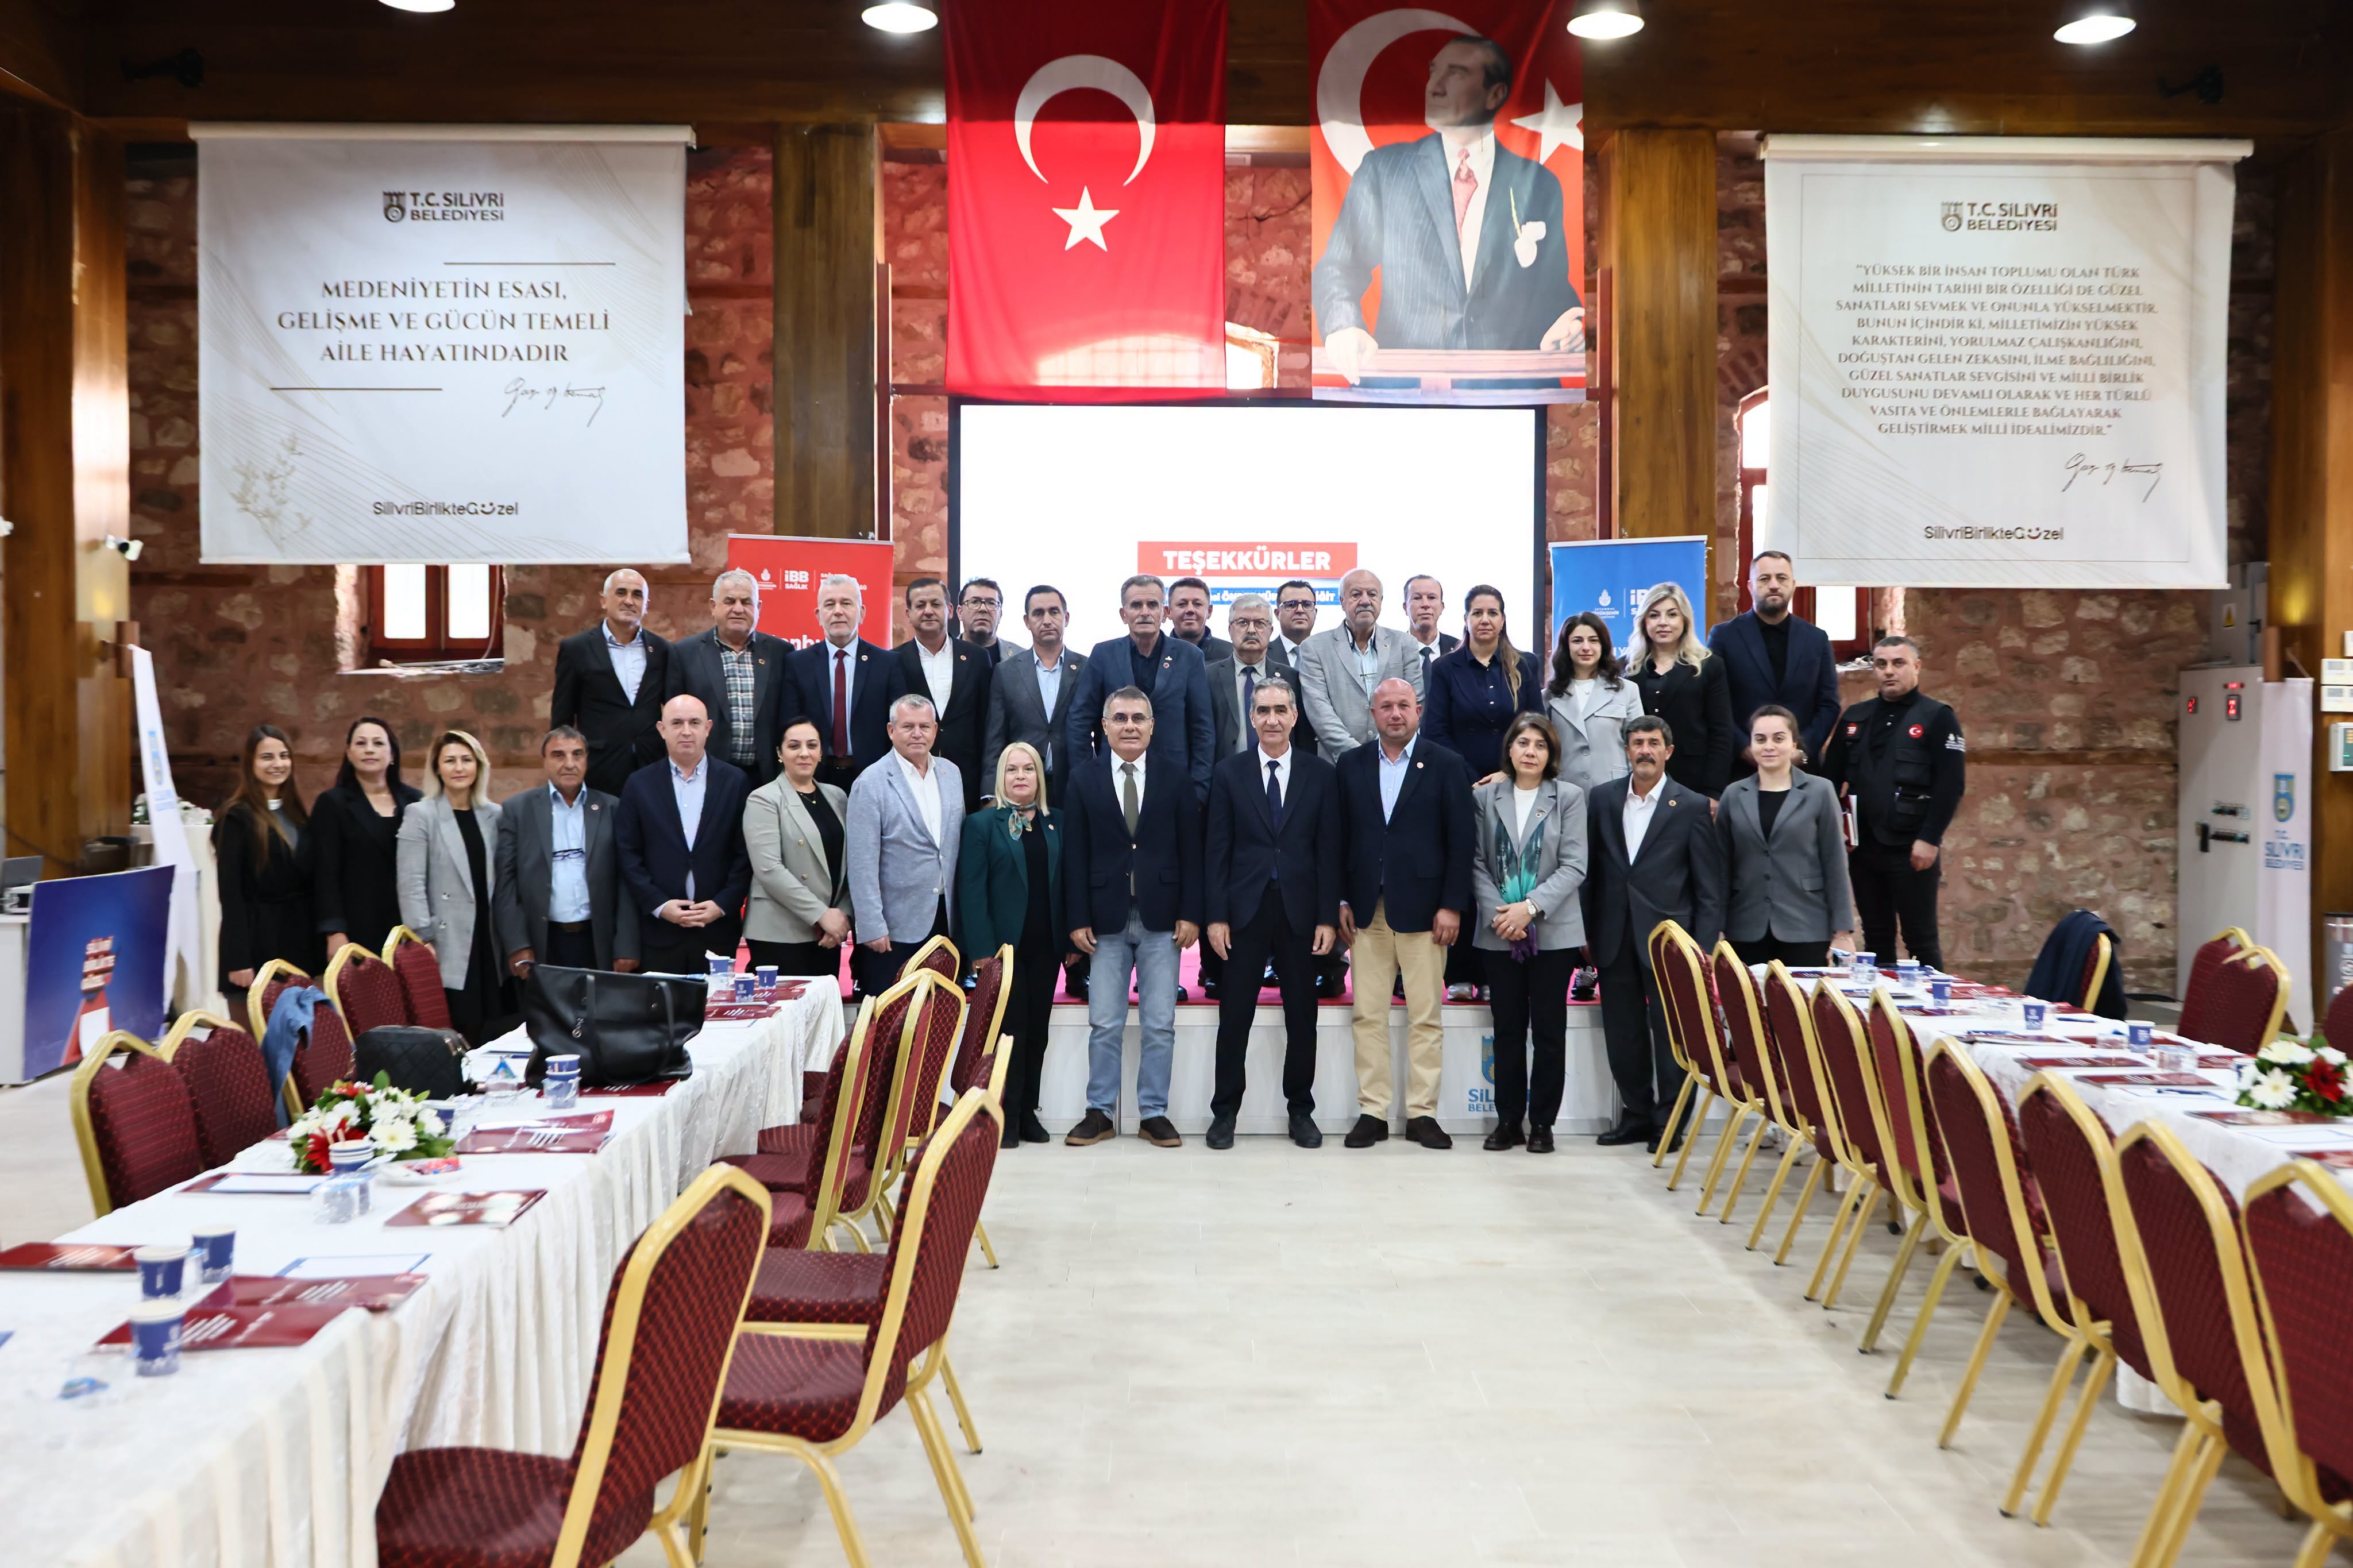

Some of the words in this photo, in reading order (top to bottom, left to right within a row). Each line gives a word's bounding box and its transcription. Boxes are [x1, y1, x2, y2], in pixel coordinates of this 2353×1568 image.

[410, 192, 439, 207] T.C.
[1967, 203, 1996, 217] T.C.
[1919, 264, 1941, 276] BİR
[1945, 264, 1986, 276] İNSAN
[1990, 266, 2058, 277] TOPLUMU
[2061, 267, 2099, 278] OLAN
[2103, 265, 2140, 278] TÜRK
[321, 277, 489, 298] MEDENİYETİN
[499, 281, 566, 300] ESASI,
[1853, 281, 1932, 294] MİLLETİNİN
[1935, 281, 1982, 294] TARİHİ
[1986, 283, 2008, 295] BİR
[2011, 282, 2073, 295] ÖZELLİĞİ
[2076, 285, 2096, 295] DE
[2098, 283, 2143, 296] GÜZEL
[1836, 300, 1911, 311] SANATLARI
[1914, 301, 1967, 311] SEVMEK
[1971, 301, 1988, 312] VE
[1991, 302, 2050, 312] ONUNLA
[277, 308, 382, 333] GELİŞME
[389, 312, 418, 329] VE
[425, 309, 516, 330] GÜCÜN
[523, 309, 610, 330] TEMELİ
[1857, 318, 1906, 328] BUNUN
[1910, 316, 1965, 331] İÇİNDİR
[1968, 316, 1985, 330] Kİ,
[1989, 318, 2081, 330] MİLLETİMİZİN
[2085, 318, 2138, 331] YÜKSEK
[1852, 335, 1947, 347] KARAKTERİNİ,
[1950, 336, 2025, 347] YORULMAZ
[320, 340, 373, 361] AİLE
[380, 344, 569, 361] HAYATINDADIR
[1838, 351, 1914, 366] DOĞUŞTAN
[1918, 353, 1962, 364] GELEN
[1966, 354, 2031, 366] ZEKASINI,
[2034, 353, 2067, 365] İLME
[1849, 368, 1893, 380] GÜZEL
[1896, 371, 1966, 381] SANATLAR
[1970, 370, 2036, 383] SEVGİSİNİ
[2039, 372, 2058, 383] VE
[2059, 371, 2096, 383] MİLLİ
[2099, 371, 2144, 384] BİRLİK
[1842, 388, 1928, 399] DUYGUSUNU
[1932, 389, 1992, 399] DEVAMLI
[1996, 390, 2051, 400] OLARAK
[2055, 390, 2072, 400] VE
[2074, 391, 2101, 401] HER
[2105, 388, 2152, 401] TÜRLÜ
[1870, 405, 1916, 416] VASITA
[1920, 406, 1936, 416] VE
[1940, 404, 2030, 418] ÖNLEMLERLE
[2032, 405, 2122, 418] BAĞLAYARAK
[1878, 422, 1968, 435] GELİŞTİRMEK
[1970, 422, 2008, 435] MİLLİ
[1163, 545, 1330, 576] TEŞEKKÜRLER
